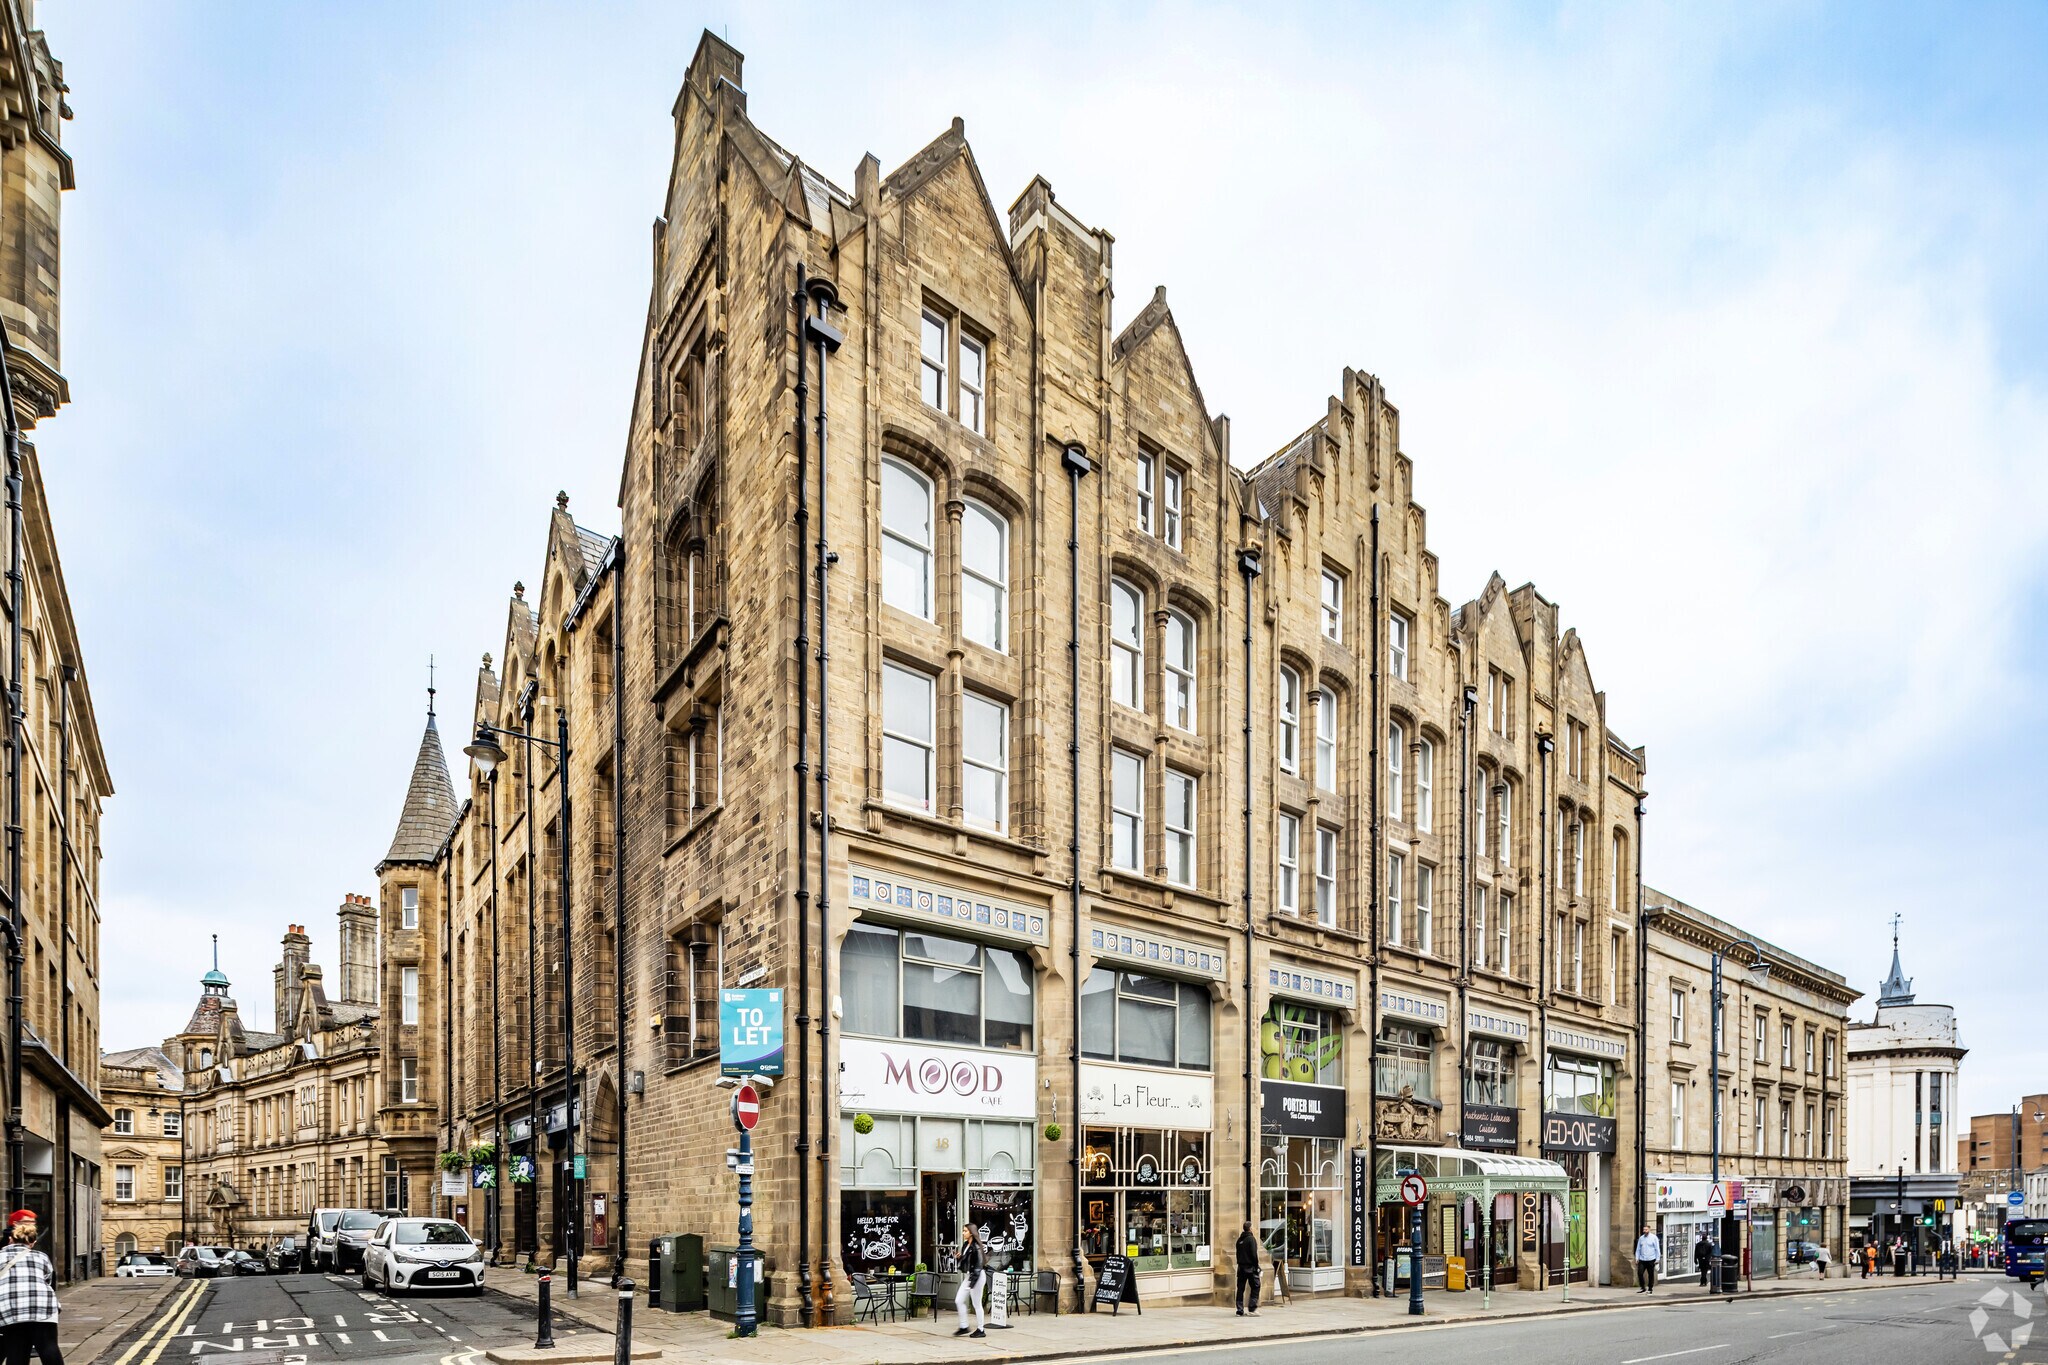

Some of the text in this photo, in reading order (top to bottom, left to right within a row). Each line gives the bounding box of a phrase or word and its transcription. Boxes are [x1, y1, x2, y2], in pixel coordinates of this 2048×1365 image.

[737, 1008, 764, 1027] TO
[733, 1026, 772, 1046] LET
[881, 1052, 1003, 1097] MOOD
[981, 1095, 1003, 1107] CAFÉ
[1113, 1083, 1131, 1107] La
[1283, 1097, 1322, 1114] PORTER HILL
[1464, 1110, 1489, 1121] Authentic
[1479, 1124, 1498, 1134] Cuisine
[1544, 1119, 1596, 1146] MED-ONE
[936, 1138, 949, 1149] 18
[1095, 1168, 1106, 1179] 16
[1354, 1157, 1362, 1264] HOPPING ARCADE
[857, 1216, 899, 1225] HELLO, TIME FOR
[172, 1311, 420, 1337] RIGHT
[190, 1330, 411, 1354] TURN
